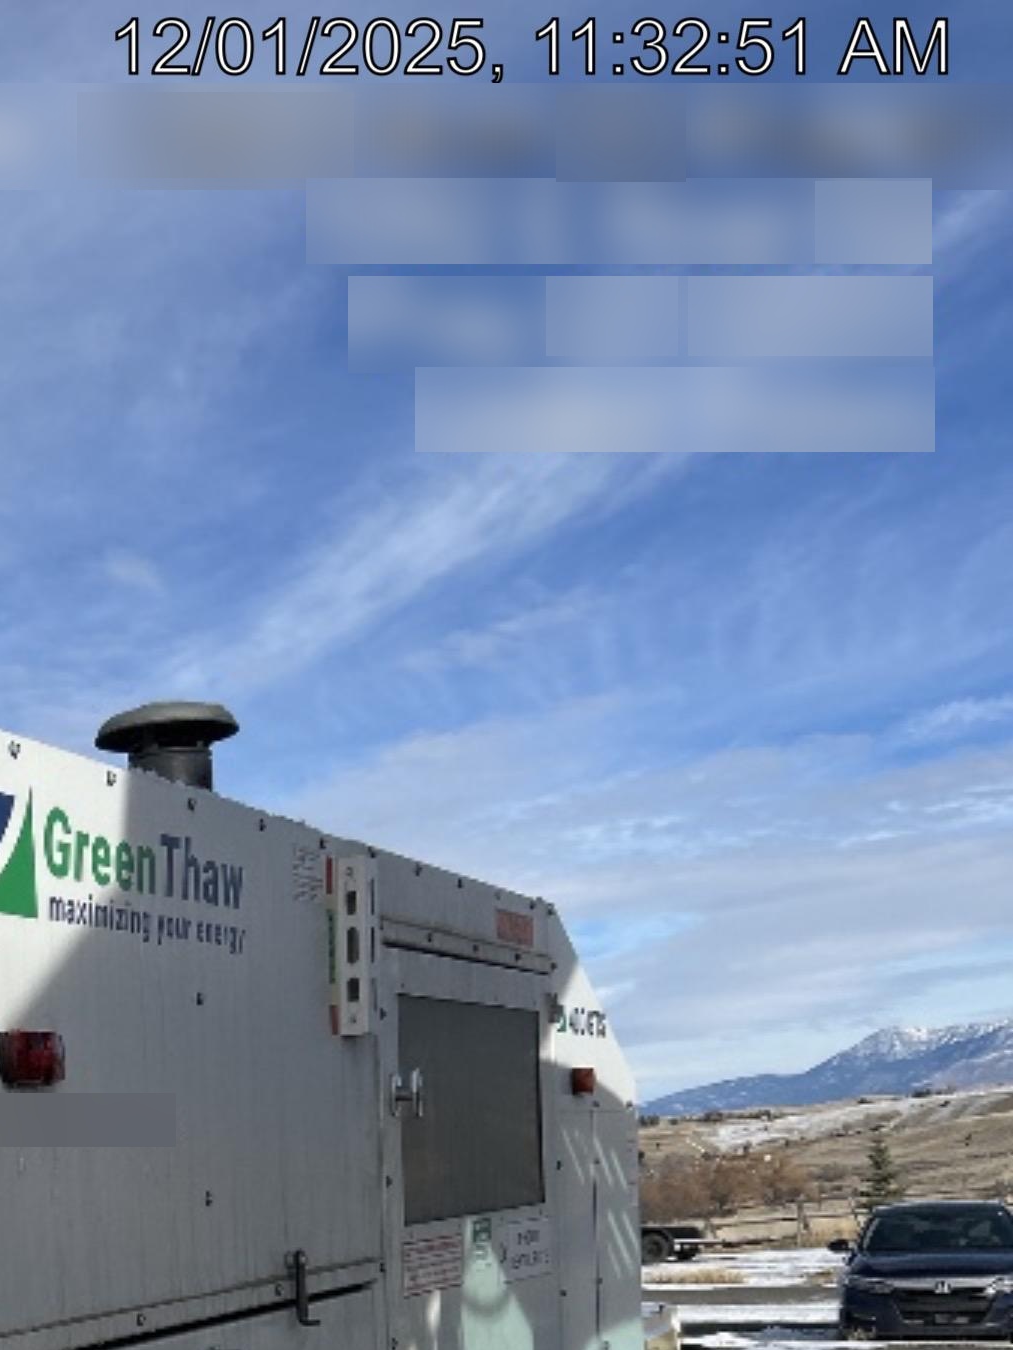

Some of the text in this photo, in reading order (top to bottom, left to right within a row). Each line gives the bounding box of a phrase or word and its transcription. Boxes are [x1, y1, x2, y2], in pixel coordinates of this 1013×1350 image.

[44, 807, 244, 910] GreenThaw
[49, 895, 246, 956] maximizing your energy
